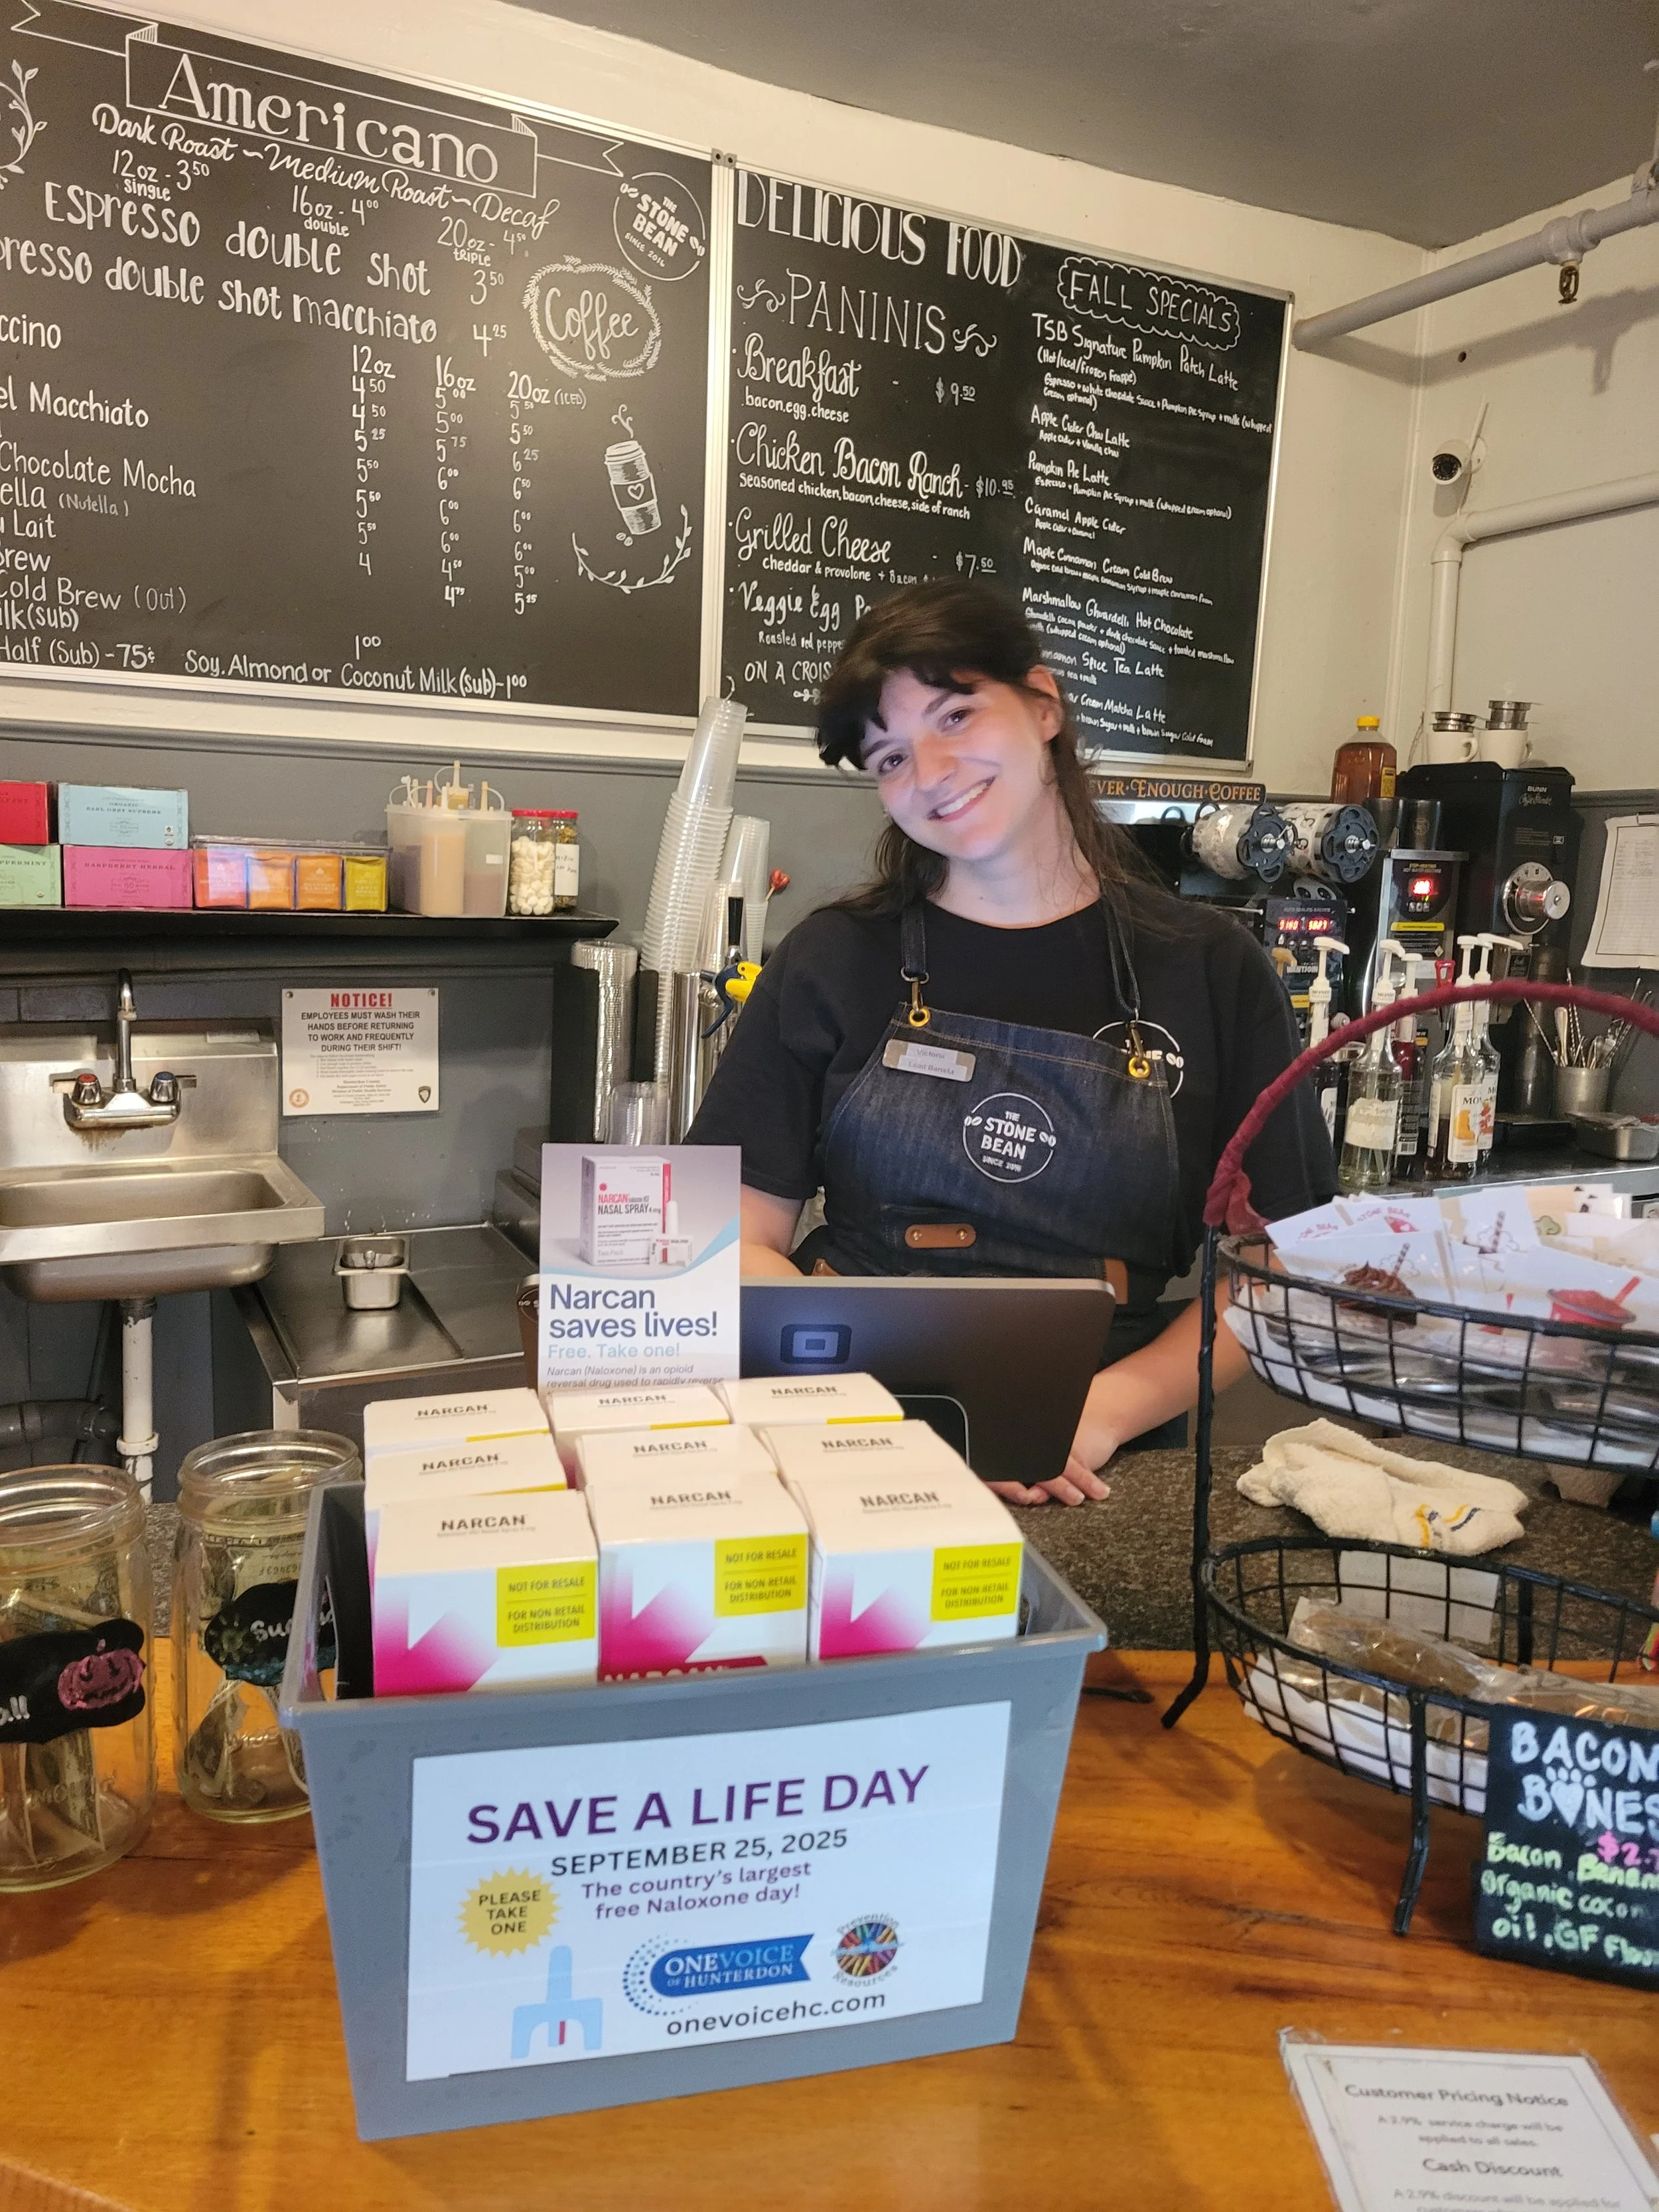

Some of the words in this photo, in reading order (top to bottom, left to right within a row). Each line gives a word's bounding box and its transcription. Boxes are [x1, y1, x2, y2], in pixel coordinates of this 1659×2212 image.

[159, 54, 498, 184] Americano
[93, 104, 156, 145] Dark
[162, 123, 238, 161] Roast
[265, 143, 381, 193] Medium
[382, 170, 453, 209] Roast
[472, 192, 560, 239] Decaf
[113, 149, 158, 182] 12oz
[293, 185, 333, 219] 16oz
[662, 196, 678, 214] THE
[304, 218, 349, 236] double
[636, 193, 689, 243] STONE
[737, 170, 926, 265] DELICIOUS
[947, 222, 1021, 287] FOOD
[437, 216, 486, 252] 20oz
[624, 232, 646, 254] SINCE
[632, 212, 678, 257] BEAN
[226, 221, 342, 275] double
[105, 256, 204, 305] double
[294, 292, 437, 344] macchiato
[786, 268, 946, 354] PANINIS
[1070, 271, 1132, 309] FALL
[1146, 287, 1232, 332] SPECIALS
[545, 287, 638, 360] Coffee
[1032, 313, 1067, 340] TSB
[1072, 325, 1127, 359] Signature
[1133, 338, 1171, 370] Pumpkin
[1181, 344, 1204, 378] Patch
[1208, 364, 1238, 391] Latte
[352, 344, 396, 378] 12oz
[436, 354, 476, 391] 16oz
[507, 370, 550, 404] 20oz
[737, 332, 862, 403] Breakfast
[30, 382, 149, 427] Macchiato
[1031, 405, 1058, 427] Apple
[1062, 412, 1084, 433] Cider
[1106, 429, 1130, 448] Latte
[0, 441, 111, 485] Chocolate
[124, 459, 196, 497] Mocha
[737, 421, 825, 477] Chicken
[833, 437, 901, 488] Bacon
[908, 451, 963, 498] Ranch
[1029, 450, 1062, 477] Pumpkin
[1083, 464, 1110, 486] Latte
[942, 505, 970, 520] ranch
[1025, 497, 1070, 522] Caramel
[1074, 511, 1100, 530] Apple
[1102, 518, 1127, 535] Cider
[14, 513, 56, 539] Lait
[735, 507, 813, 561] Grilled
[822, 516, 891, 563] Cheese
[762, 555, 811, 573] cheddar
[825, 566, 871, 581] provolone
[1023, 537, 1055, 560] Maple
[1057, 548, 1097, 570] Cinnamon
[1103, 558, 1129, 577] Cream
[58, 577, 121, 610] Brew
[739, 581, 802, 626] Veggie
[810, 585, 840, 632] Egg
[1023, 587, 1081, 611] Marshmallow
[1136, 611, 1151, 630] Hot
[1154, 619, 1194, 640] Chocolate
[342, 663, 415, 691] Coconut
[419, 667, 457, 693] Milk
[745, 661, 768, 684] ON
[775, 662, 786, 684] A
[1114, 657, 1131, 675] Tea
[1135, 661, 1165, 678] Latte
[1104, 699, 1133, 717] Matcha
[1136, 705, 1167, 724] Latte
[1131, 778, 1204, 799] ENOUGH
[1208, 783, 1262, 802] COFFEE
[330, 993, 392, 1007] NOTICE!
[984, 1117, 1037, 1142] STONE
[981, 1134, 1026, 1159] BEAN
[598, 1205, 622, 1215] NASAL
[625, 1203, 648, 1214] SPRAY
[549, 1284, 655, 1309] Narcan
[549, 1317, 636, 1339] saves
[645, 1311, 717, 1337] lives!
[548, 1344, 591, 1359] Free.
[597, 1343, 638, 1359] Take
[644, 1343, 680, 1358] one!
[547, 1366, 581, 1376] Narcan
[585, 1365, 636, 1376] (Naloxone)
[664, 1364, 693, 1376] opioid
[547, 1378, 587, 1387] reversal
[589, 1378, 611, 1388] drug
[614, 1377, 638, 1386] used
[599, 1394, 666, 1406] NARCAN
[771, 1386, 837, 1396] NARCAN
[417, 1404, 488, 1418] NARCAN
[634, 1440, 707, 1454] NARCAN
[822, 1438, 893, 1449] NARCAN
[422, 1453, 500, 1471] NARCAN
[650, 1490, 731, 1506] NARCAN
[860, 1491, 939, 1508] NARCAN
[441, 1514, 526, 1532] NARCAN
[509, 1582, 528, 1593] NOT
[531, 1580, 549, 1590] FOR
[552, 1576, 585, 1588] RESALE
[730, 1589, 792, 1603] DISTRIBUTION
[514, 1618, 580, 1633] DISTRIBUTION
[1510, 1722, 1659, 1783] BACON
[467, 1795, 617, 1844] SAVE
[634, 1792, 672, 1832] A
[691, 1779, 805, 1825] LIFE
[824, 1764, 929, 1812] DAY
[551, 1842, 726, 1877] SEPTEMBER
[735, 1838, 772, 1859] 25,
[781, 1829, 847, 1854] 2025
[582, 1882, 622, 1899] The
[629, 1870, 731, 1895] country's
[740, 1862, 811, 1883] largest
[478, 1889, 540, 1906] PLEASE
[597, 1903, 639, 1919] free
[648, 1889, 749, 1914] Naloxone
[757, 1883, 800, 1906] day!
[486, 1905, 528, 1920] TAKE
[836, 1913, 900, 1935] Prevention
[491, 1921, 526, 1935] ONE
[684, 1961, 794, 1988] HUNTERDON
[833, 1964, 899, 1988] Resources
[666, 1992, 885, 2035] onevoicehc.com
[1345, 2084, 1433, 2102] Customer
[1439, 2089, 1503, 2107] Pricing
[1506, 2092, 1569, 2107] Notice
[1423, 2158, 1470, 2174] Cash
[1475, 2160, 1563, 2178] Discount
